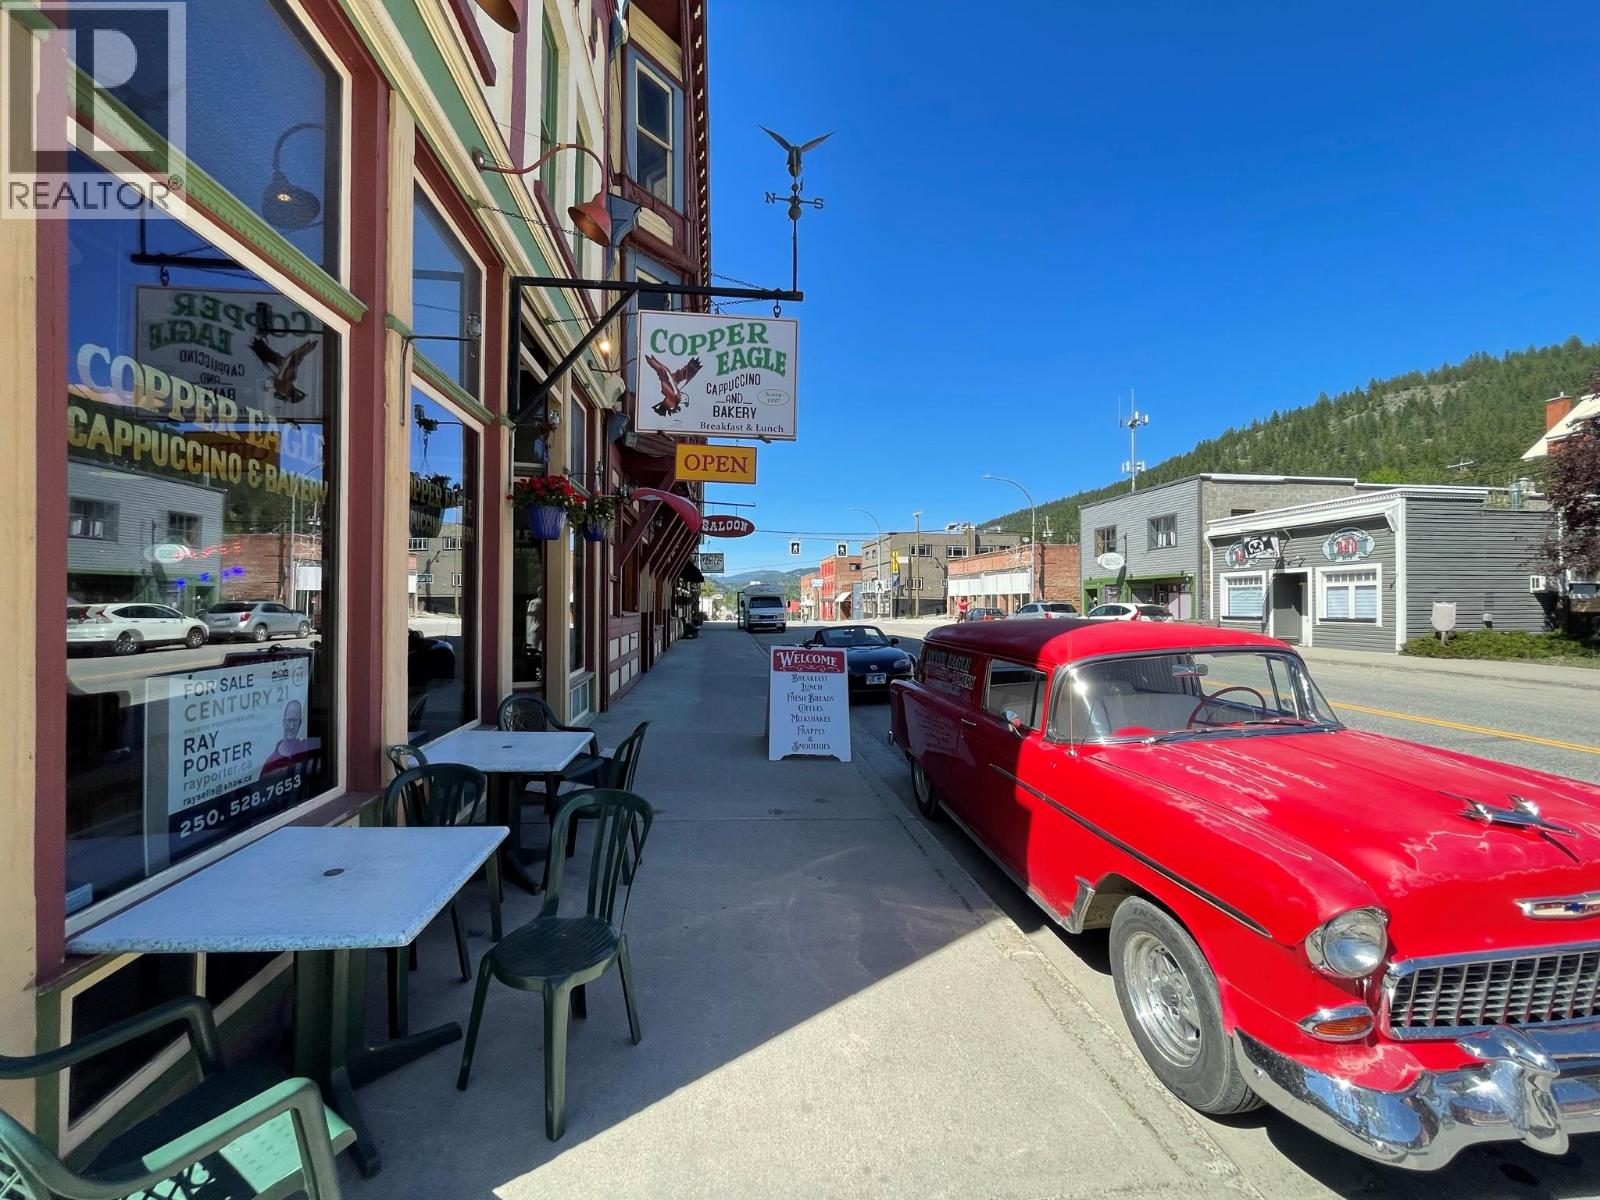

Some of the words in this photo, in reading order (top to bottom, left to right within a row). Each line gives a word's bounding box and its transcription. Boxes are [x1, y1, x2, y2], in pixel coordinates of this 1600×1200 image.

[765, 192, 776, 204] N
[814, 198, 824, 209] S
[650, 322, 769, 356] COPPER
[716, 347, 786, 377] EAGLE
[706, 373, 761, 396] CAPPUCCINO
[77, 343, 240, 441] COPPER
[246, 405, 325, 466] EAGLE
[726, 393, 743, 405] AND
[713, 405, 757, 419] BAKERY
[700, 421, 743, 432] Breakfast
[746, 424, 753, 432] &
[755, 424, 784, 433] Lunch
[67, 405, 241, 485] CAPPUCCINO
[247, 458, 263, 488] &
[265, 463, 329, 502] BAKERY
[684, 454, 749, 474] OPEN
[702, 519, 748, 533] SALOON
[776, 650, 838, 667] WELCOME
[184, 680, 216, 699] FOR
[220, 673, 254, 692] SALE
[184, 688, 273, 722] CENTURY
[276, 685, 289, 702] 21
[184, 731, 219, 756] RAY
[183, 741, 252, 777] PORTER
[183, 760, 252, 792] rayporter.ca
[183, 774, 252, 806] raysells@shaw.ca
[230, 774, 302, 816] 528.7653
